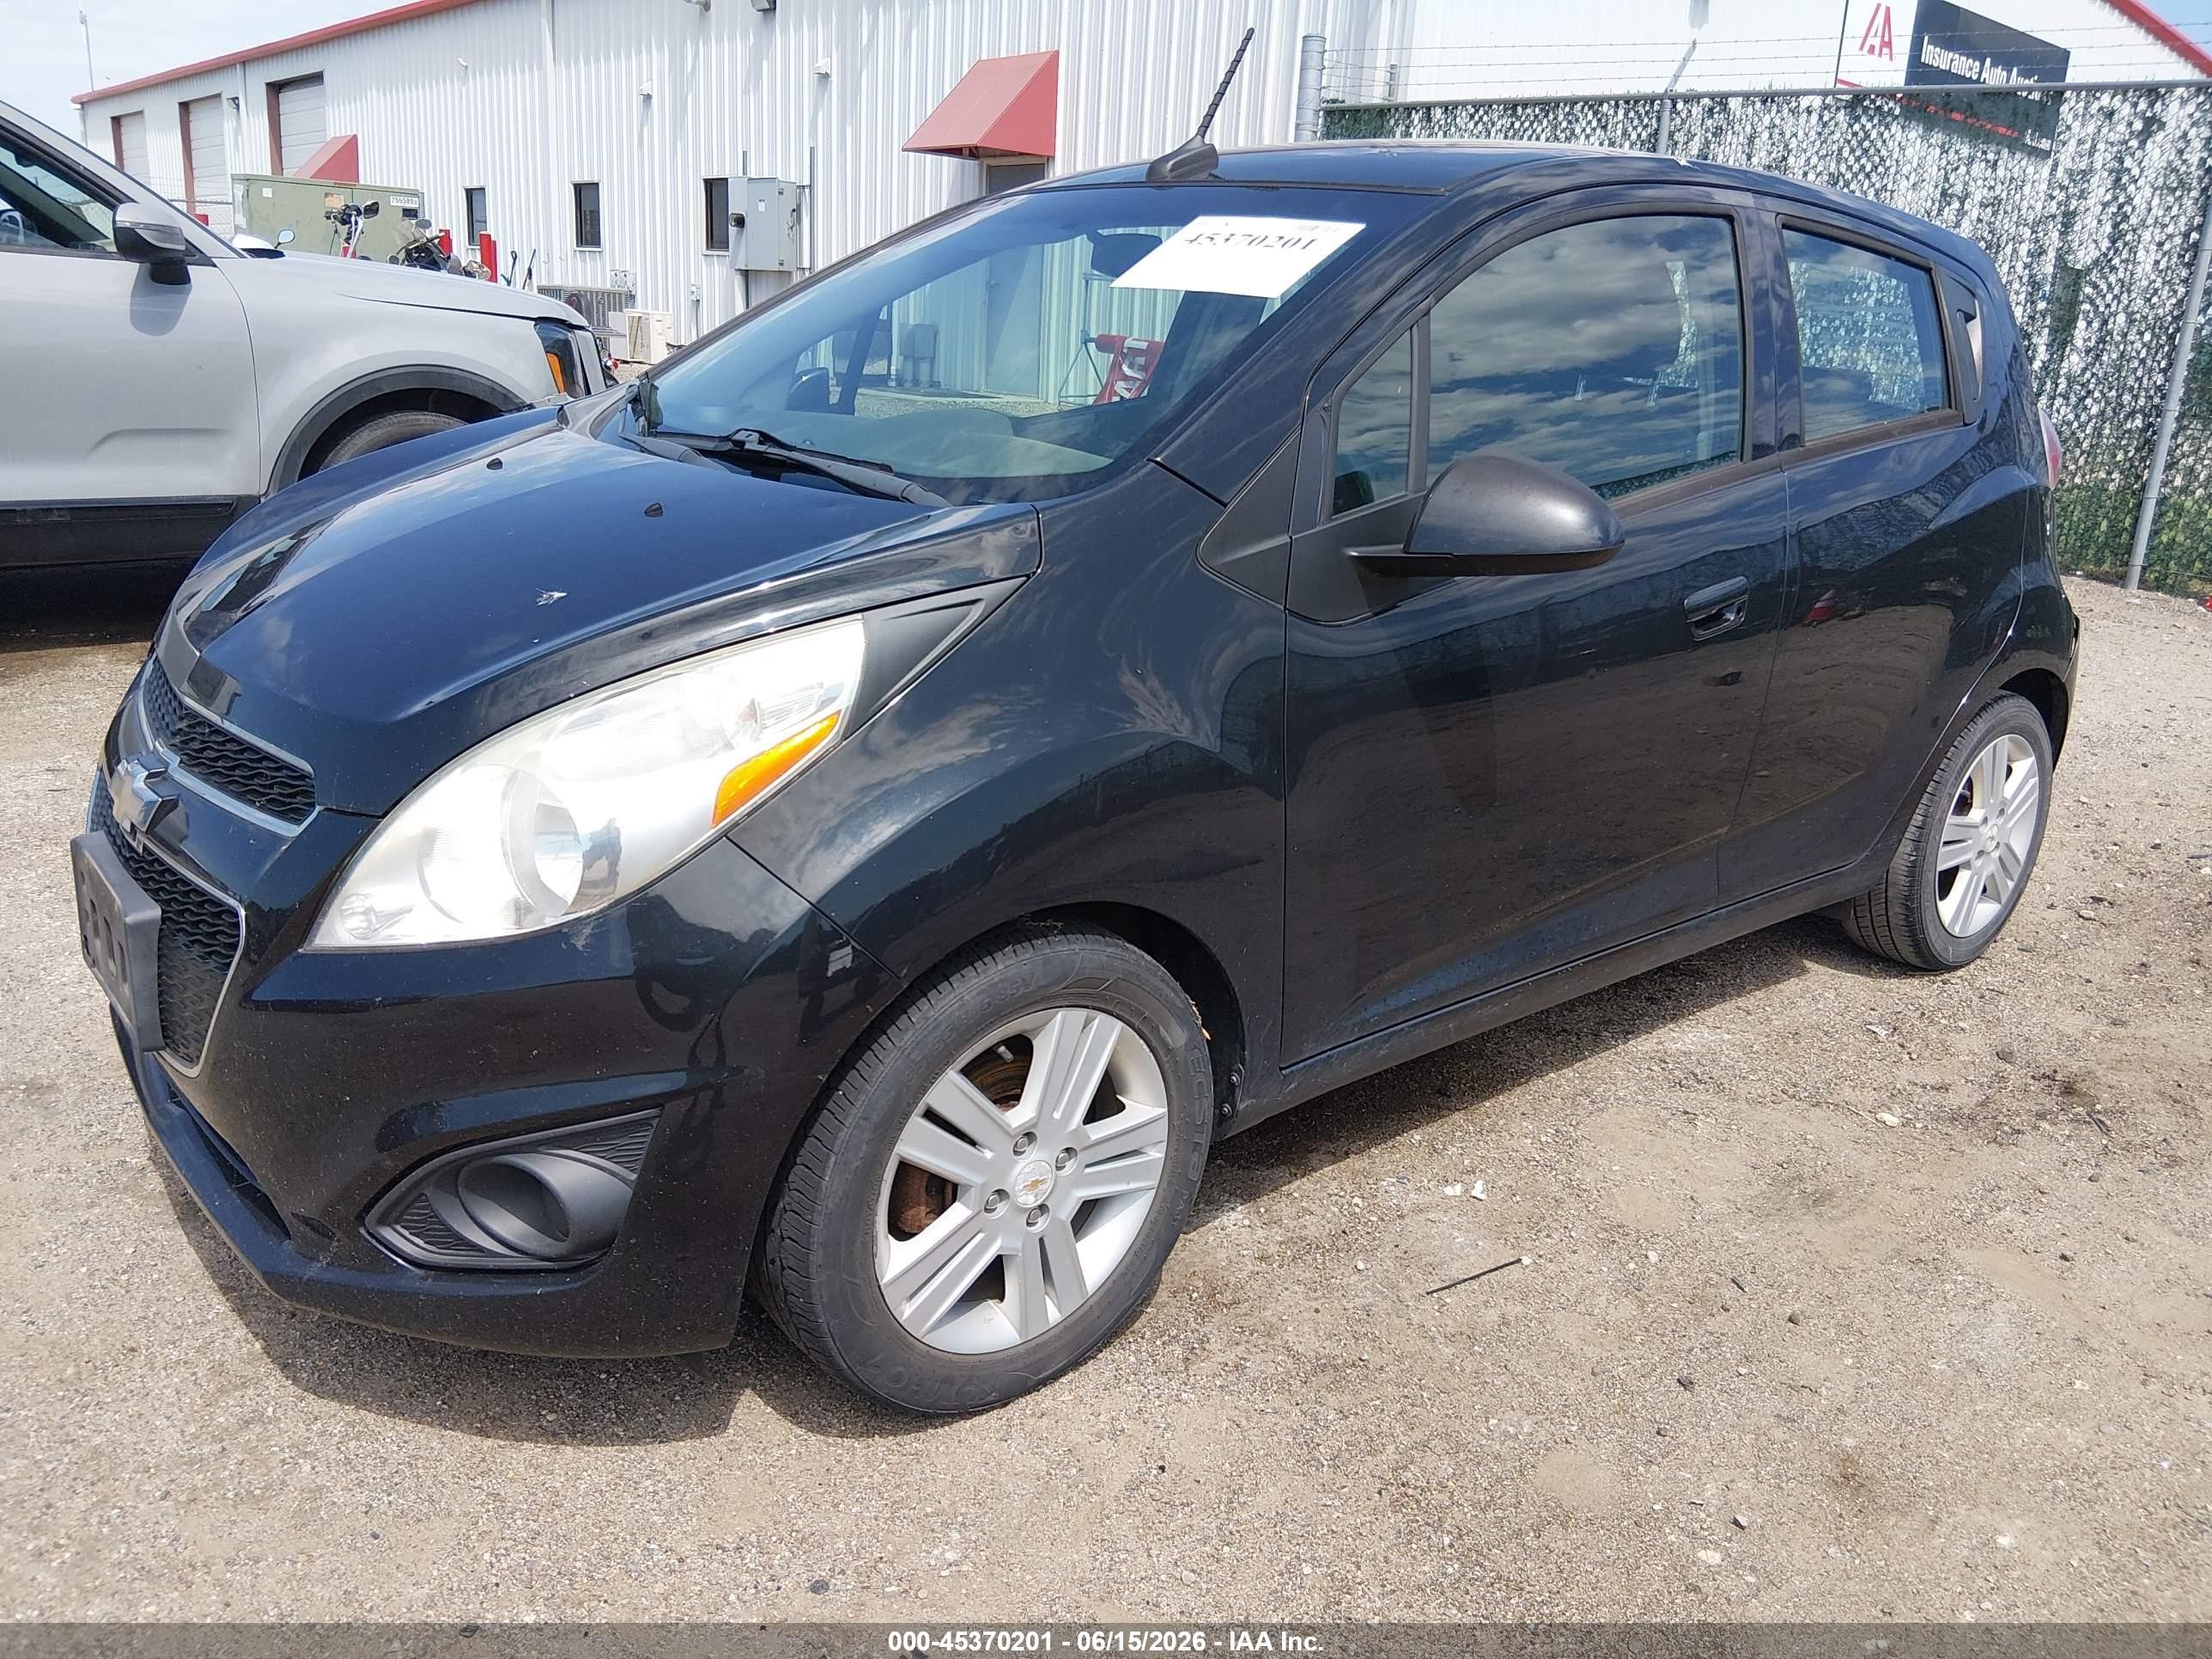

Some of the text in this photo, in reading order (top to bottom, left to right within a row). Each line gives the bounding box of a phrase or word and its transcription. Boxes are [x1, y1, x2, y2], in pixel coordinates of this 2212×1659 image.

[1920, 35, 1980, 81] Insurance
[1980, 58, 2007, 85] Auto
[1184, 233, 1318, 250] 45370201
